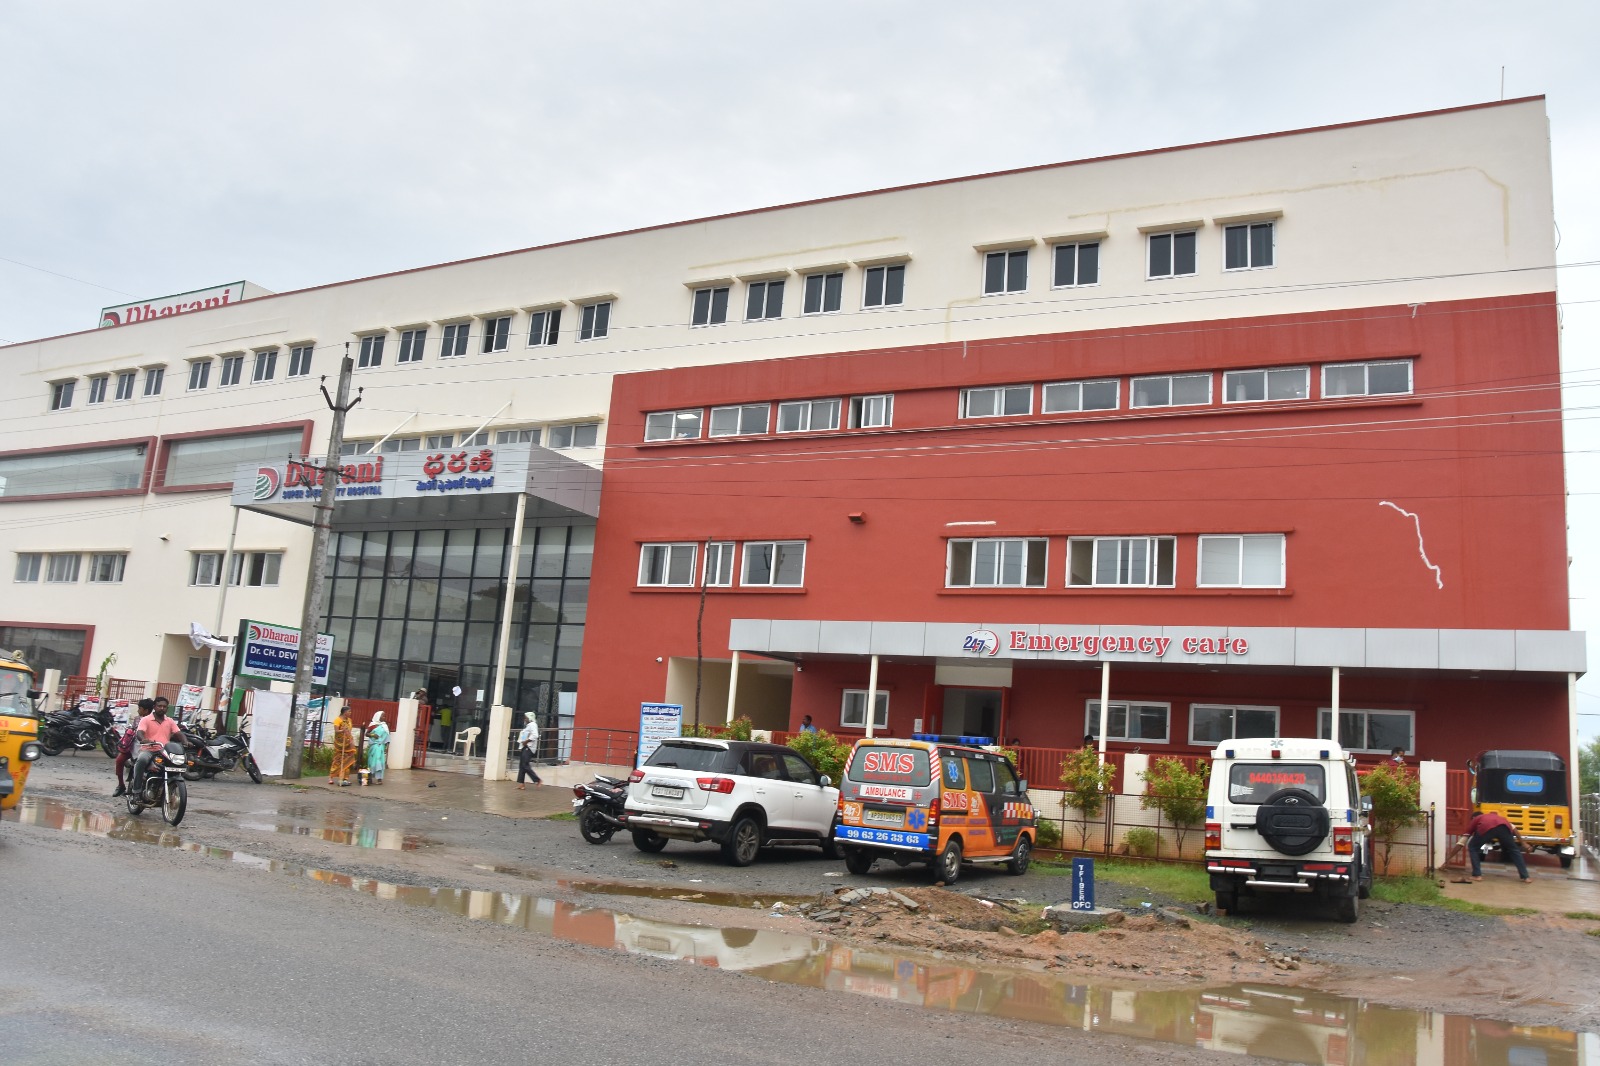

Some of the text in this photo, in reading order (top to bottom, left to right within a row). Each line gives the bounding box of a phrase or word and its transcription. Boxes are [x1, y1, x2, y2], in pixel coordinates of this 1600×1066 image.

[282, 489, 305, 500] SUPER
[347, 485, 383, 497] HOSPITAL
[261, 627, 299, 644] Dharani
[1008, 630, 1249, 657] Emergency care
[249, 646, 261, 655] Dr.
[262, 648, 277, 658] CH.
[863, 751, 915, 774] SMS
[865, 786, 907, 798] AMBULANCE
[942, 791, 968, 809] SMS
[847, 829, 920, 844] 99 63 26 33 63
[1072, 901, 1092, 909] OFC
